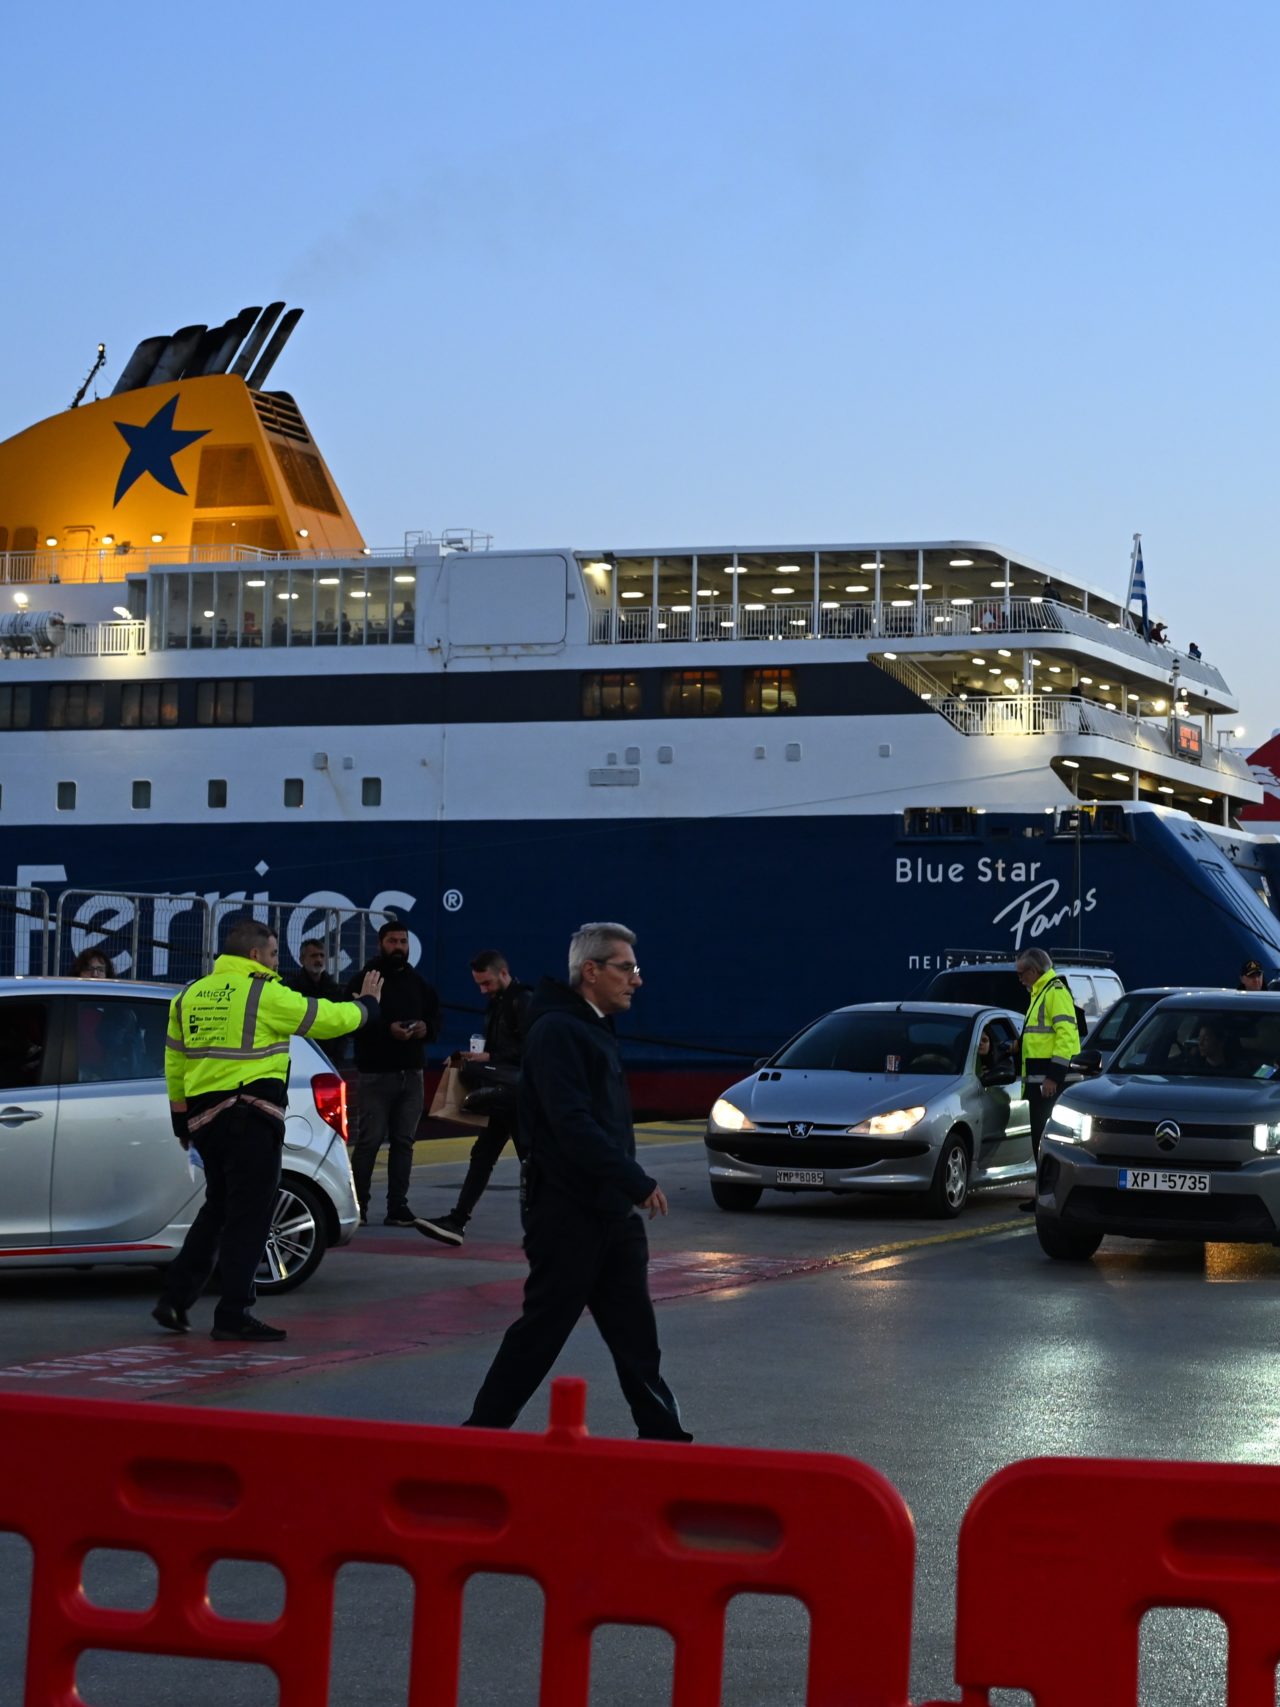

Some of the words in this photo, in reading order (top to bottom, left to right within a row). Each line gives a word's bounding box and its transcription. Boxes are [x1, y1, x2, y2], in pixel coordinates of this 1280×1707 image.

[896, 857, 963, 884] Blue
[977, 857, 1042, 884] Star
[15, 860, 422, 977] Ferries
